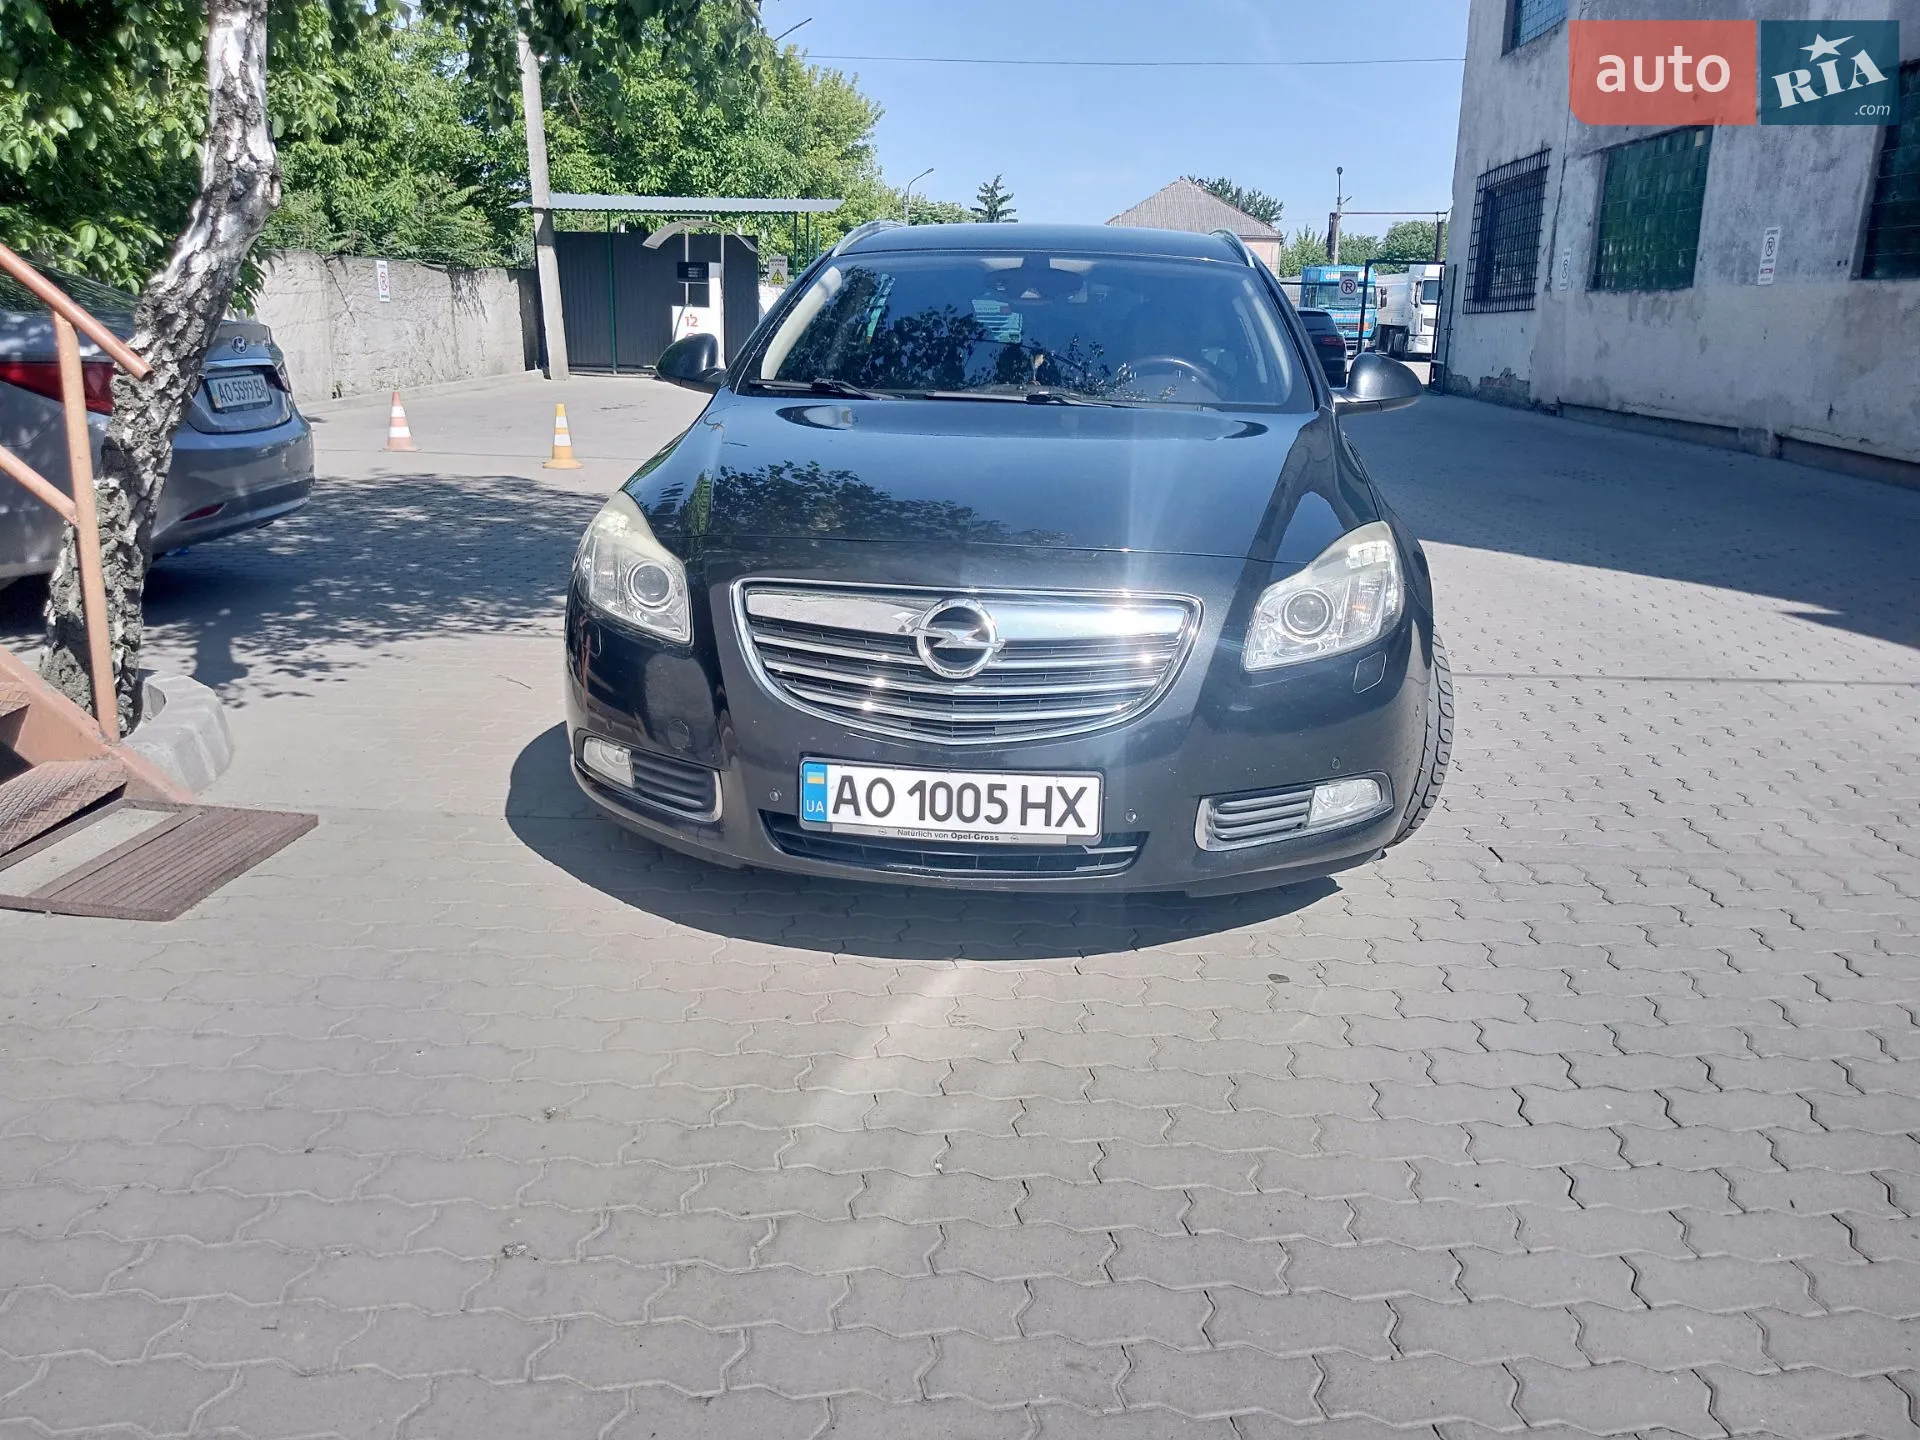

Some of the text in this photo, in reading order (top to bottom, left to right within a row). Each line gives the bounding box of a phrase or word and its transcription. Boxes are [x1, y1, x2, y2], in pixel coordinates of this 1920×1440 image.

[806, 800, 825, 813] UA
[832, 775, 1088, 828] AO 1005 HX
